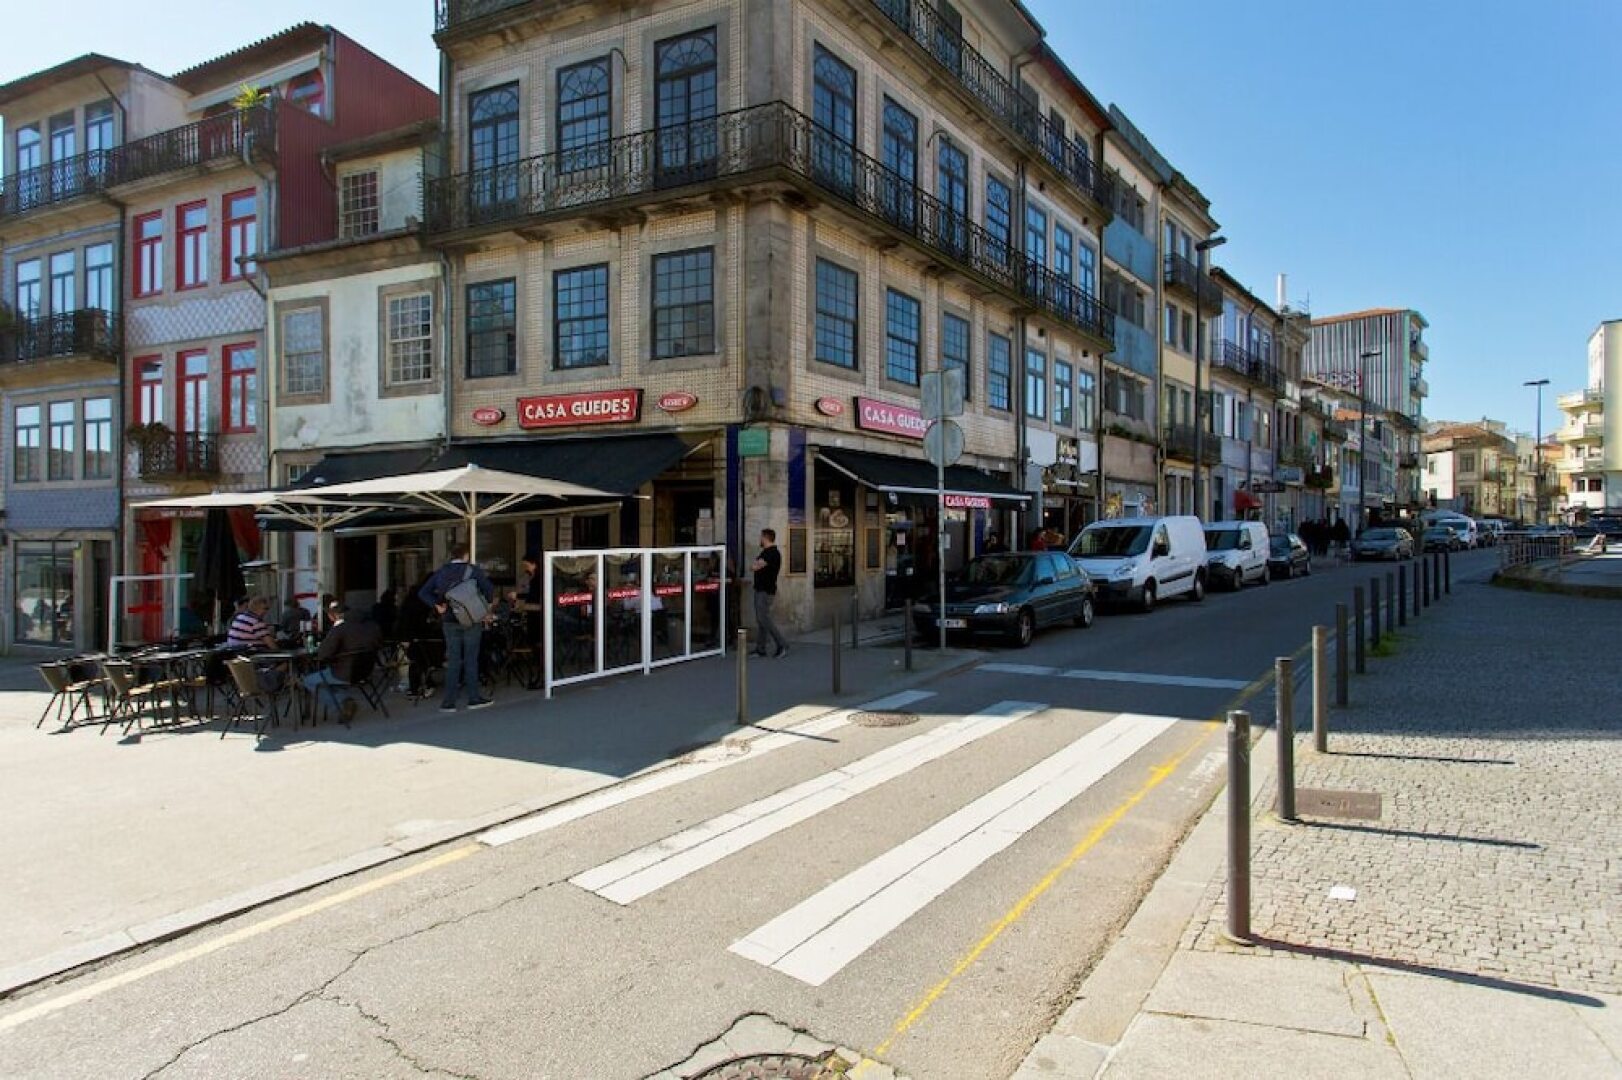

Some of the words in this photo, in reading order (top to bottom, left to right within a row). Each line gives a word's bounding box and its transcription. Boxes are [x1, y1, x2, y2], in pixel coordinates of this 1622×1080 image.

[525, 403, 566, 419] CASA
[571, 398, 630, 415] GUEDES
[864, 406, 895, 427] CASA
